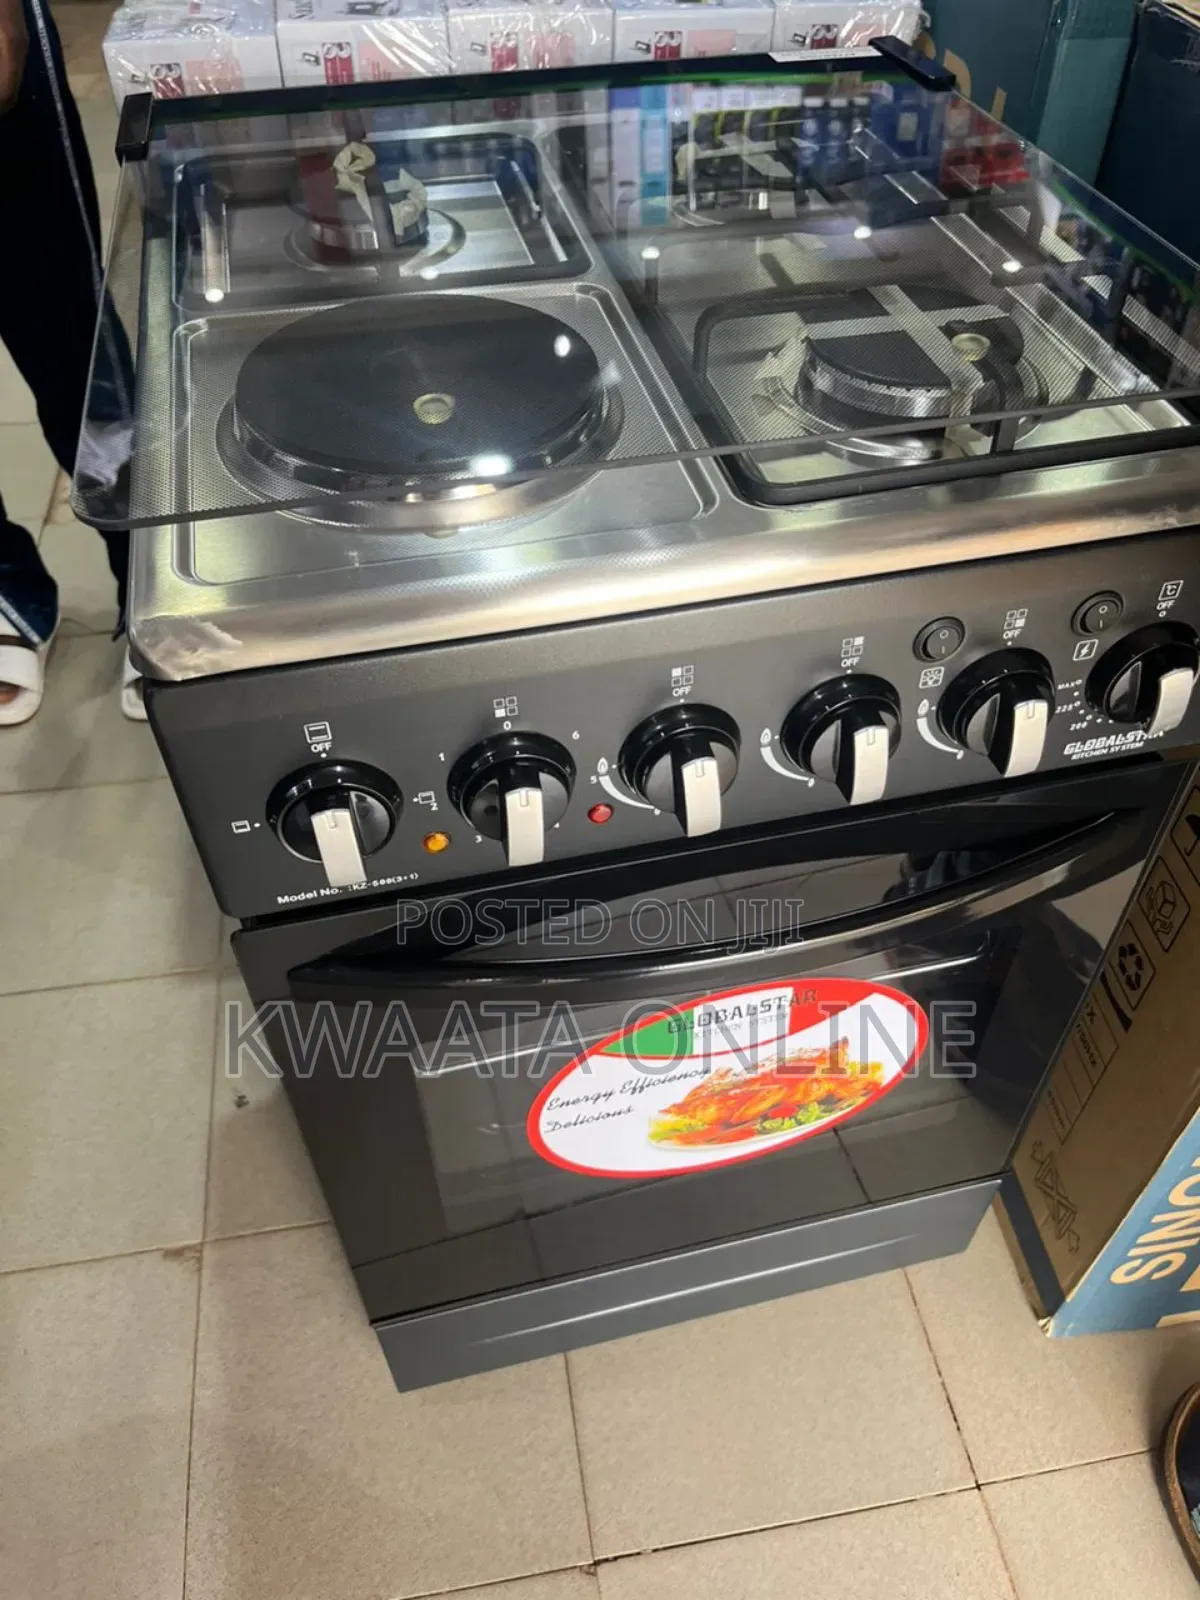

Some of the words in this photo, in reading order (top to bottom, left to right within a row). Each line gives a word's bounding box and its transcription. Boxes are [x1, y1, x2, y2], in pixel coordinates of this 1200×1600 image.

[1156, 600, 1175, 610] OFF
[1003, 629, 1021, 639] OFF
[841, 658, 860, 667] OFF
[672, 687, 692, 696] OFF
[572, 729, 580, 740] 6
[310, 741, 332, 753] OFF
[438, 752, 446, 762] 1
[590, 775, 598, 785] 5
[430, 802, 439, 811] 2
[276, 889, 318, 905] Model
[319, 885, 343, 898] No.
[667, 988, 817, 1035] GLOBALSTAR
[546, 1088, 618, 1112] Energy
[619, 1066, 713, 1095] Efficiency
[543, 1104, 636, 1135] Delicious
